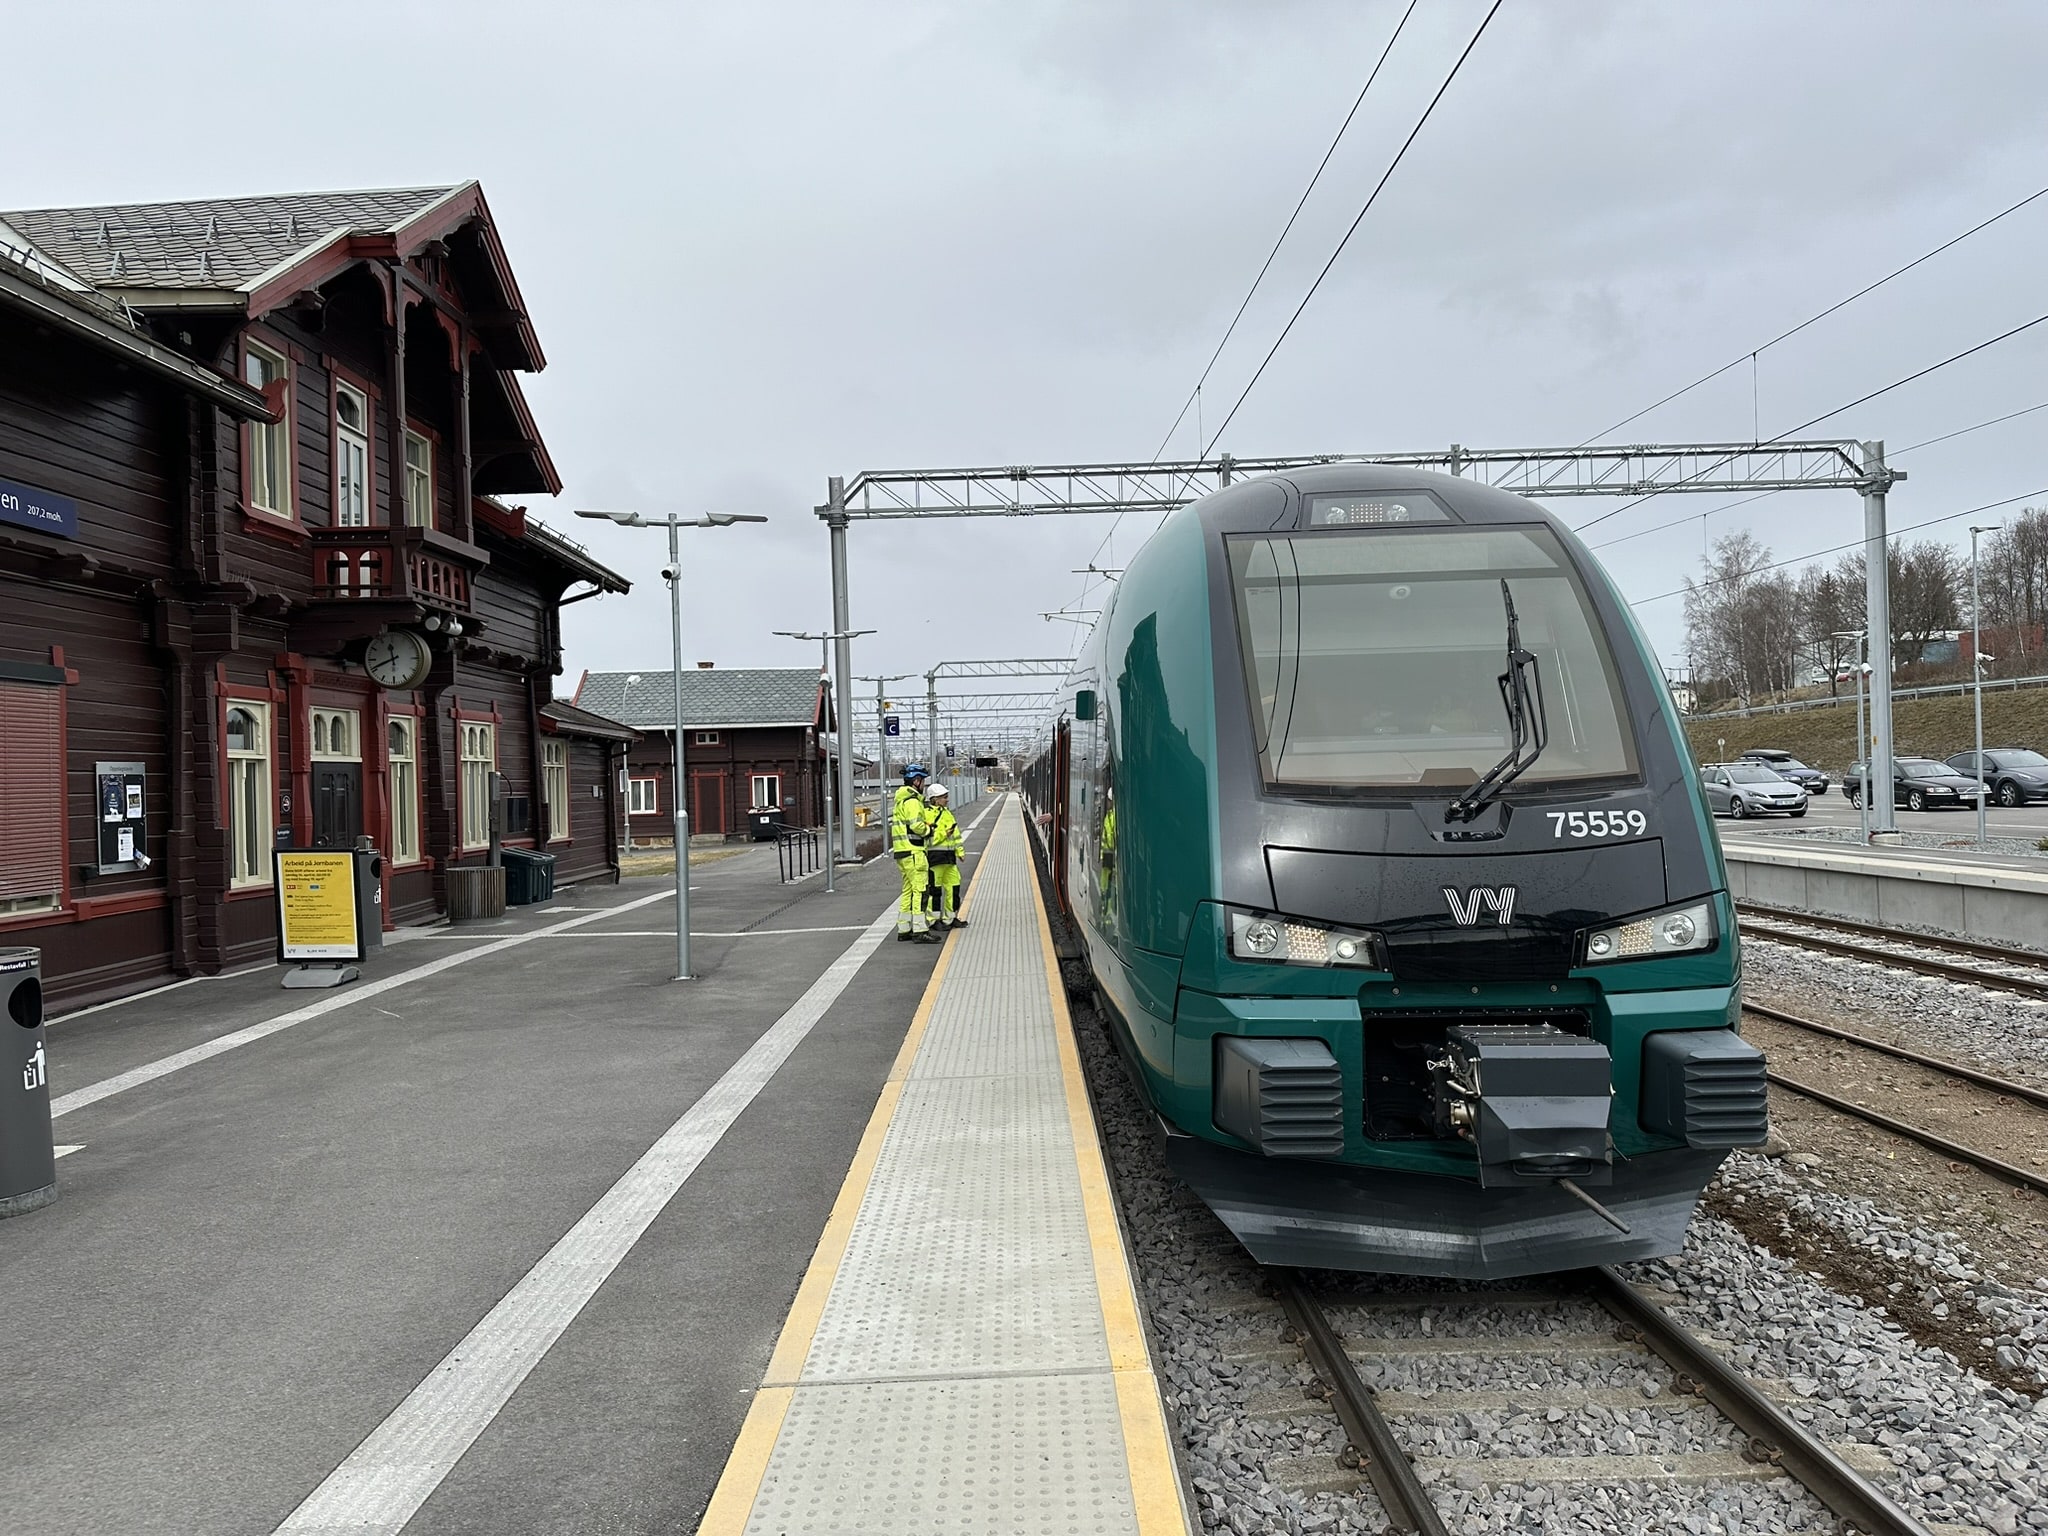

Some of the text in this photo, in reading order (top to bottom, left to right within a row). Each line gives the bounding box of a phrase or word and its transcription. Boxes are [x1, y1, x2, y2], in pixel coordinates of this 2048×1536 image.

[0, 493, 63, 523] en 207,2 moh.
[889, 724, 896, 734] C
[1546, 809, 1647, 838] 75559
[1442, 887, 1516, 925] VY
